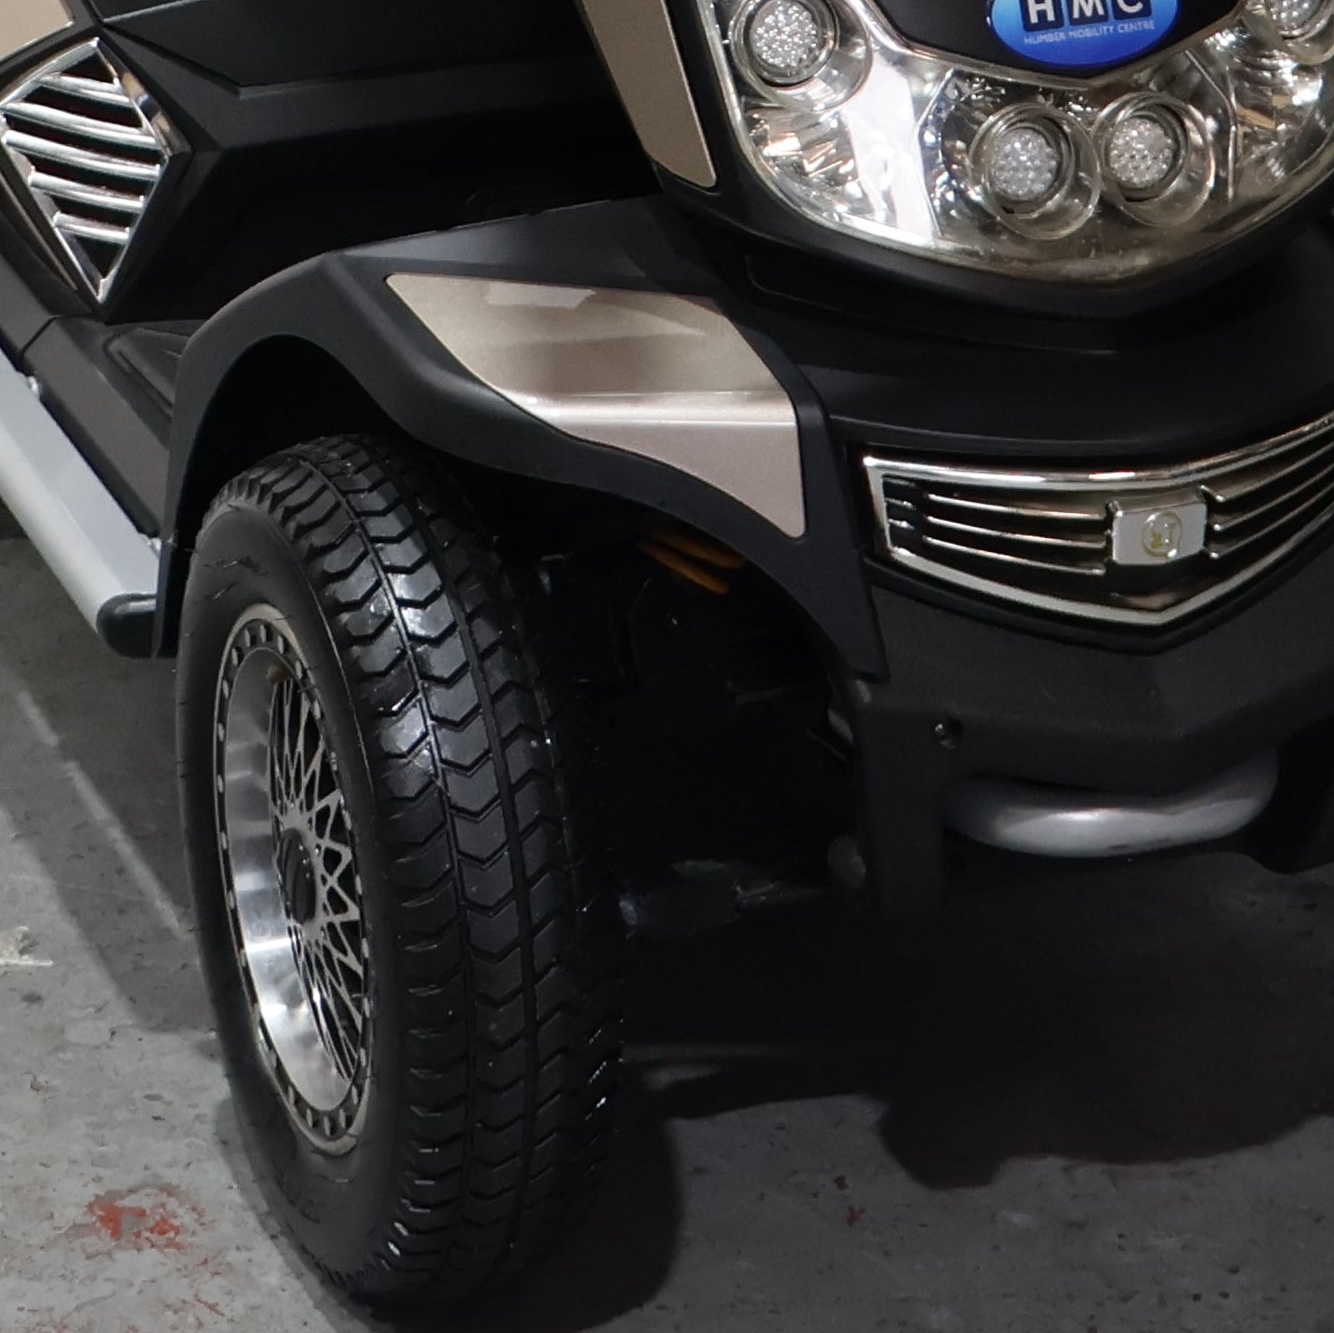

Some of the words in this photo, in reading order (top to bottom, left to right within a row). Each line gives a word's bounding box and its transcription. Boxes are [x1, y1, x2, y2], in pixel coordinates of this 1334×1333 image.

[1024, 32, 1066, 46] HUMBER
[1069, 25, 1115, 40] MOBILITY
[1118, 19, 1155, 34] CENTRE
